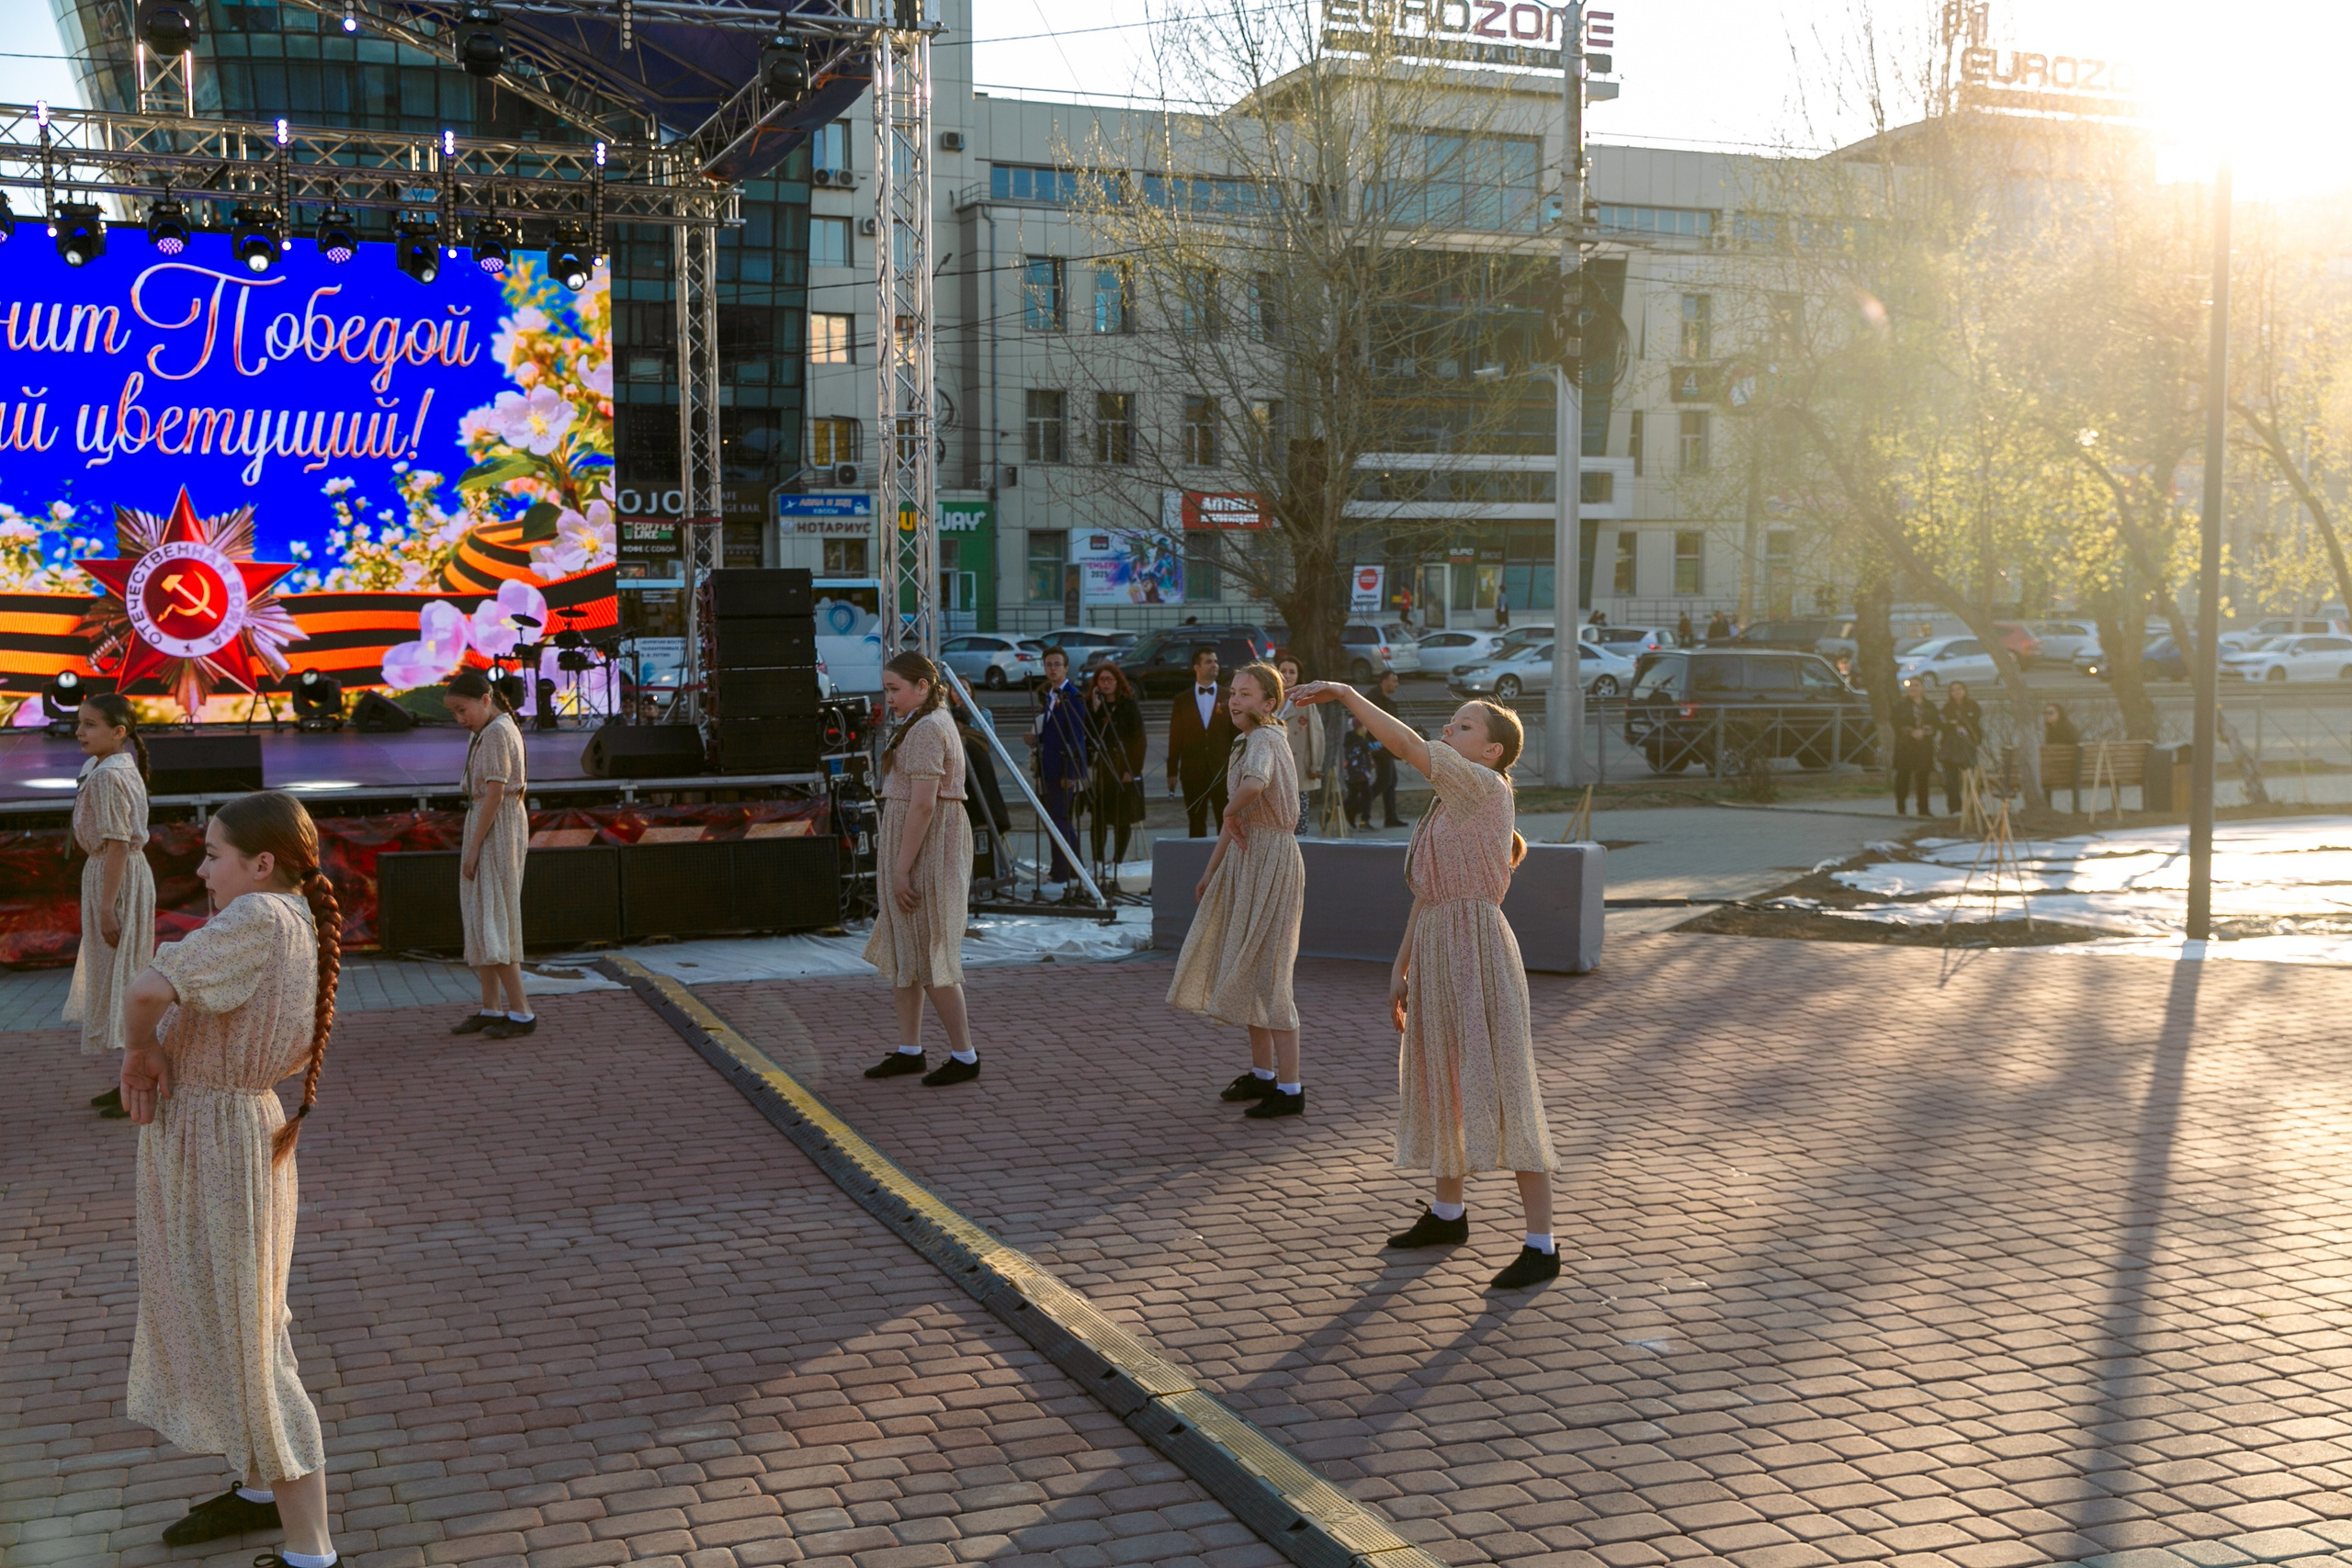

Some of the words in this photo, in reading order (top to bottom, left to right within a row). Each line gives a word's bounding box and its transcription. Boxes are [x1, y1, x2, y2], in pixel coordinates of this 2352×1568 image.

[130, 263, 480, 393] Победой
[75, 371, 435, 486] цветущий!
[634, 522, 676, 531] COFFEE
[634, 531, 659, 539] LIKE
[797, 523, 872, 533] НОТАРИУС
[128, 544, 231, 645] ОТЕЧЕСТВЕННАЯ
